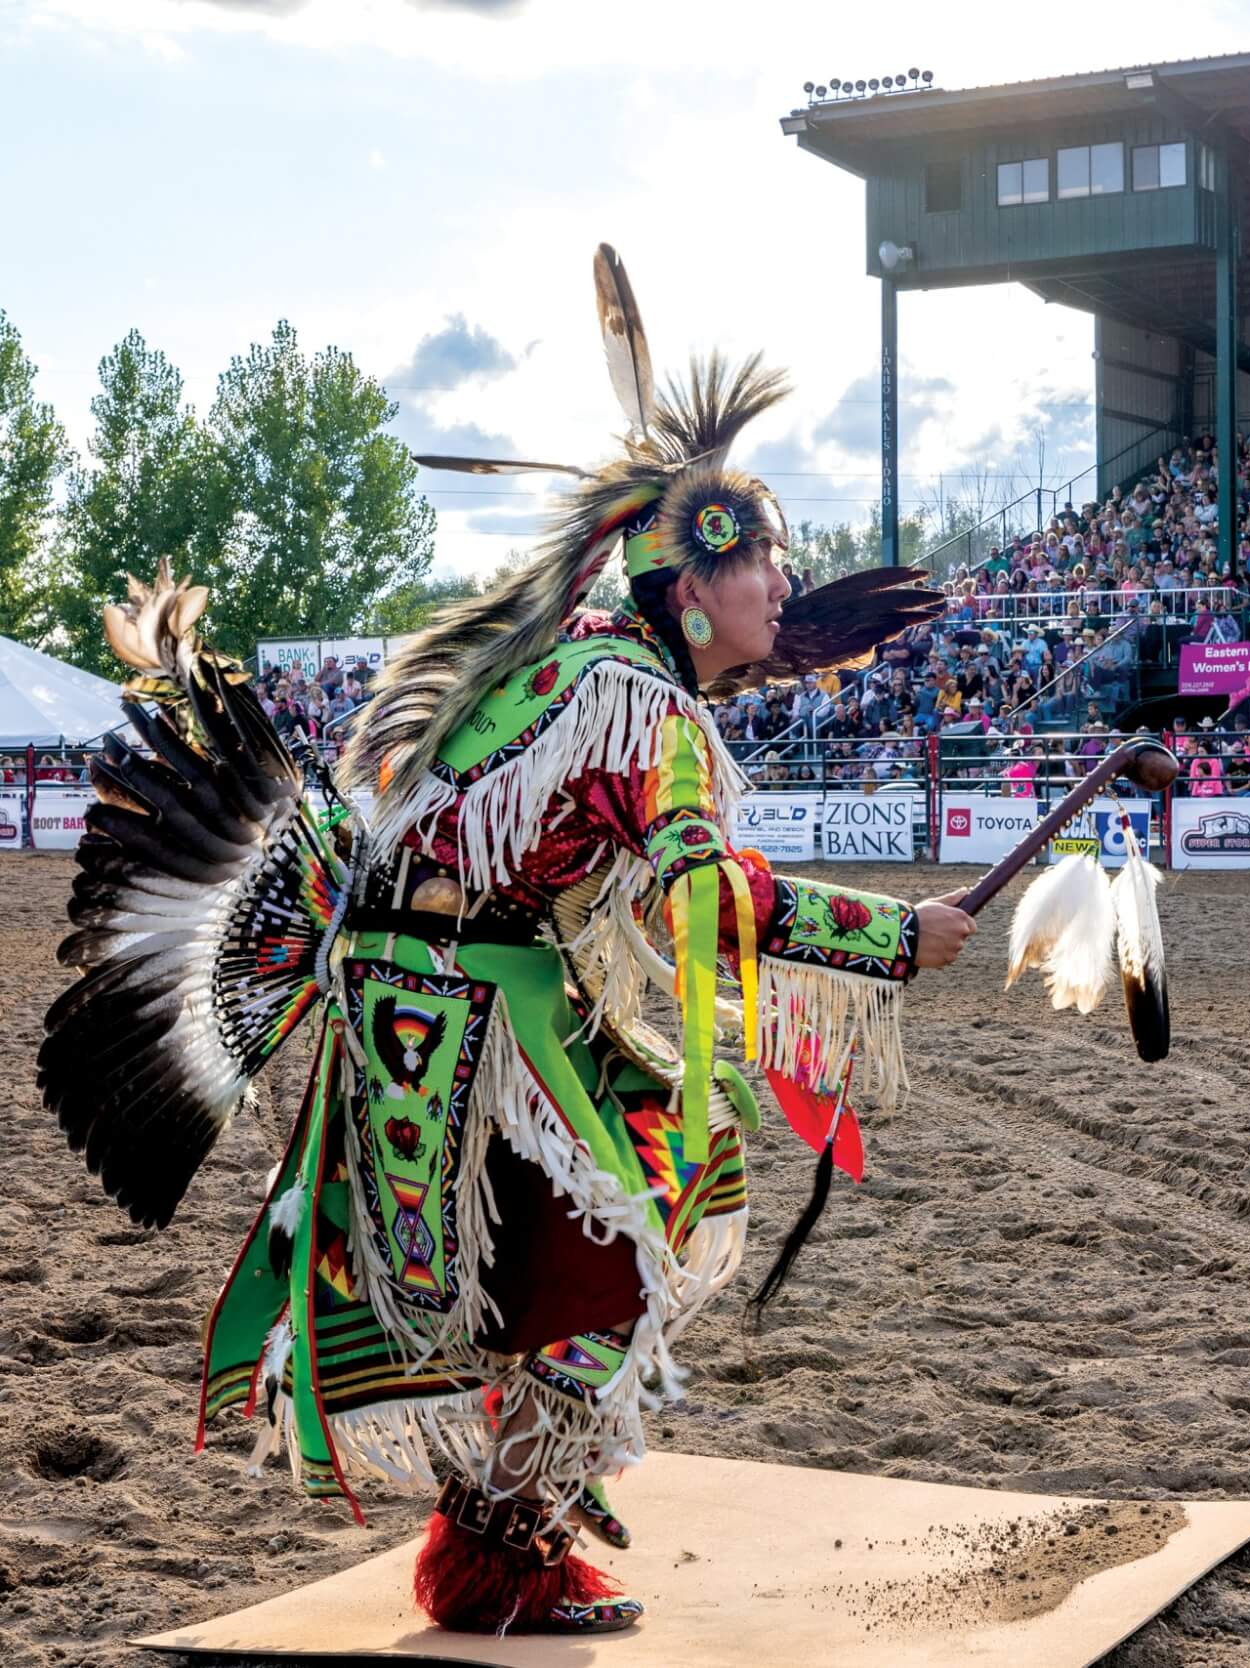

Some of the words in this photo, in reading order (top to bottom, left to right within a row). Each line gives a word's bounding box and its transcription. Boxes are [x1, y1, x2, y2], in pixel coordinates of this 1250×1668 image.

[278, 648, 309, 663] BANK
[1205, 647, 1248, 658] Eastern
[1192, 661, 1245, 673] Women's
[827, 802, 906, 825] ZIONS
[33, 817, 61, 830] BOOT
[63, 816, 86, 830] BAR
[976, 817, 1032, 830] TOYOTA
[827, 831, 907, 855] BANK
[1055, 842, 1096, 852] NEW
[1188, 838, 1221, 848] SUPER
